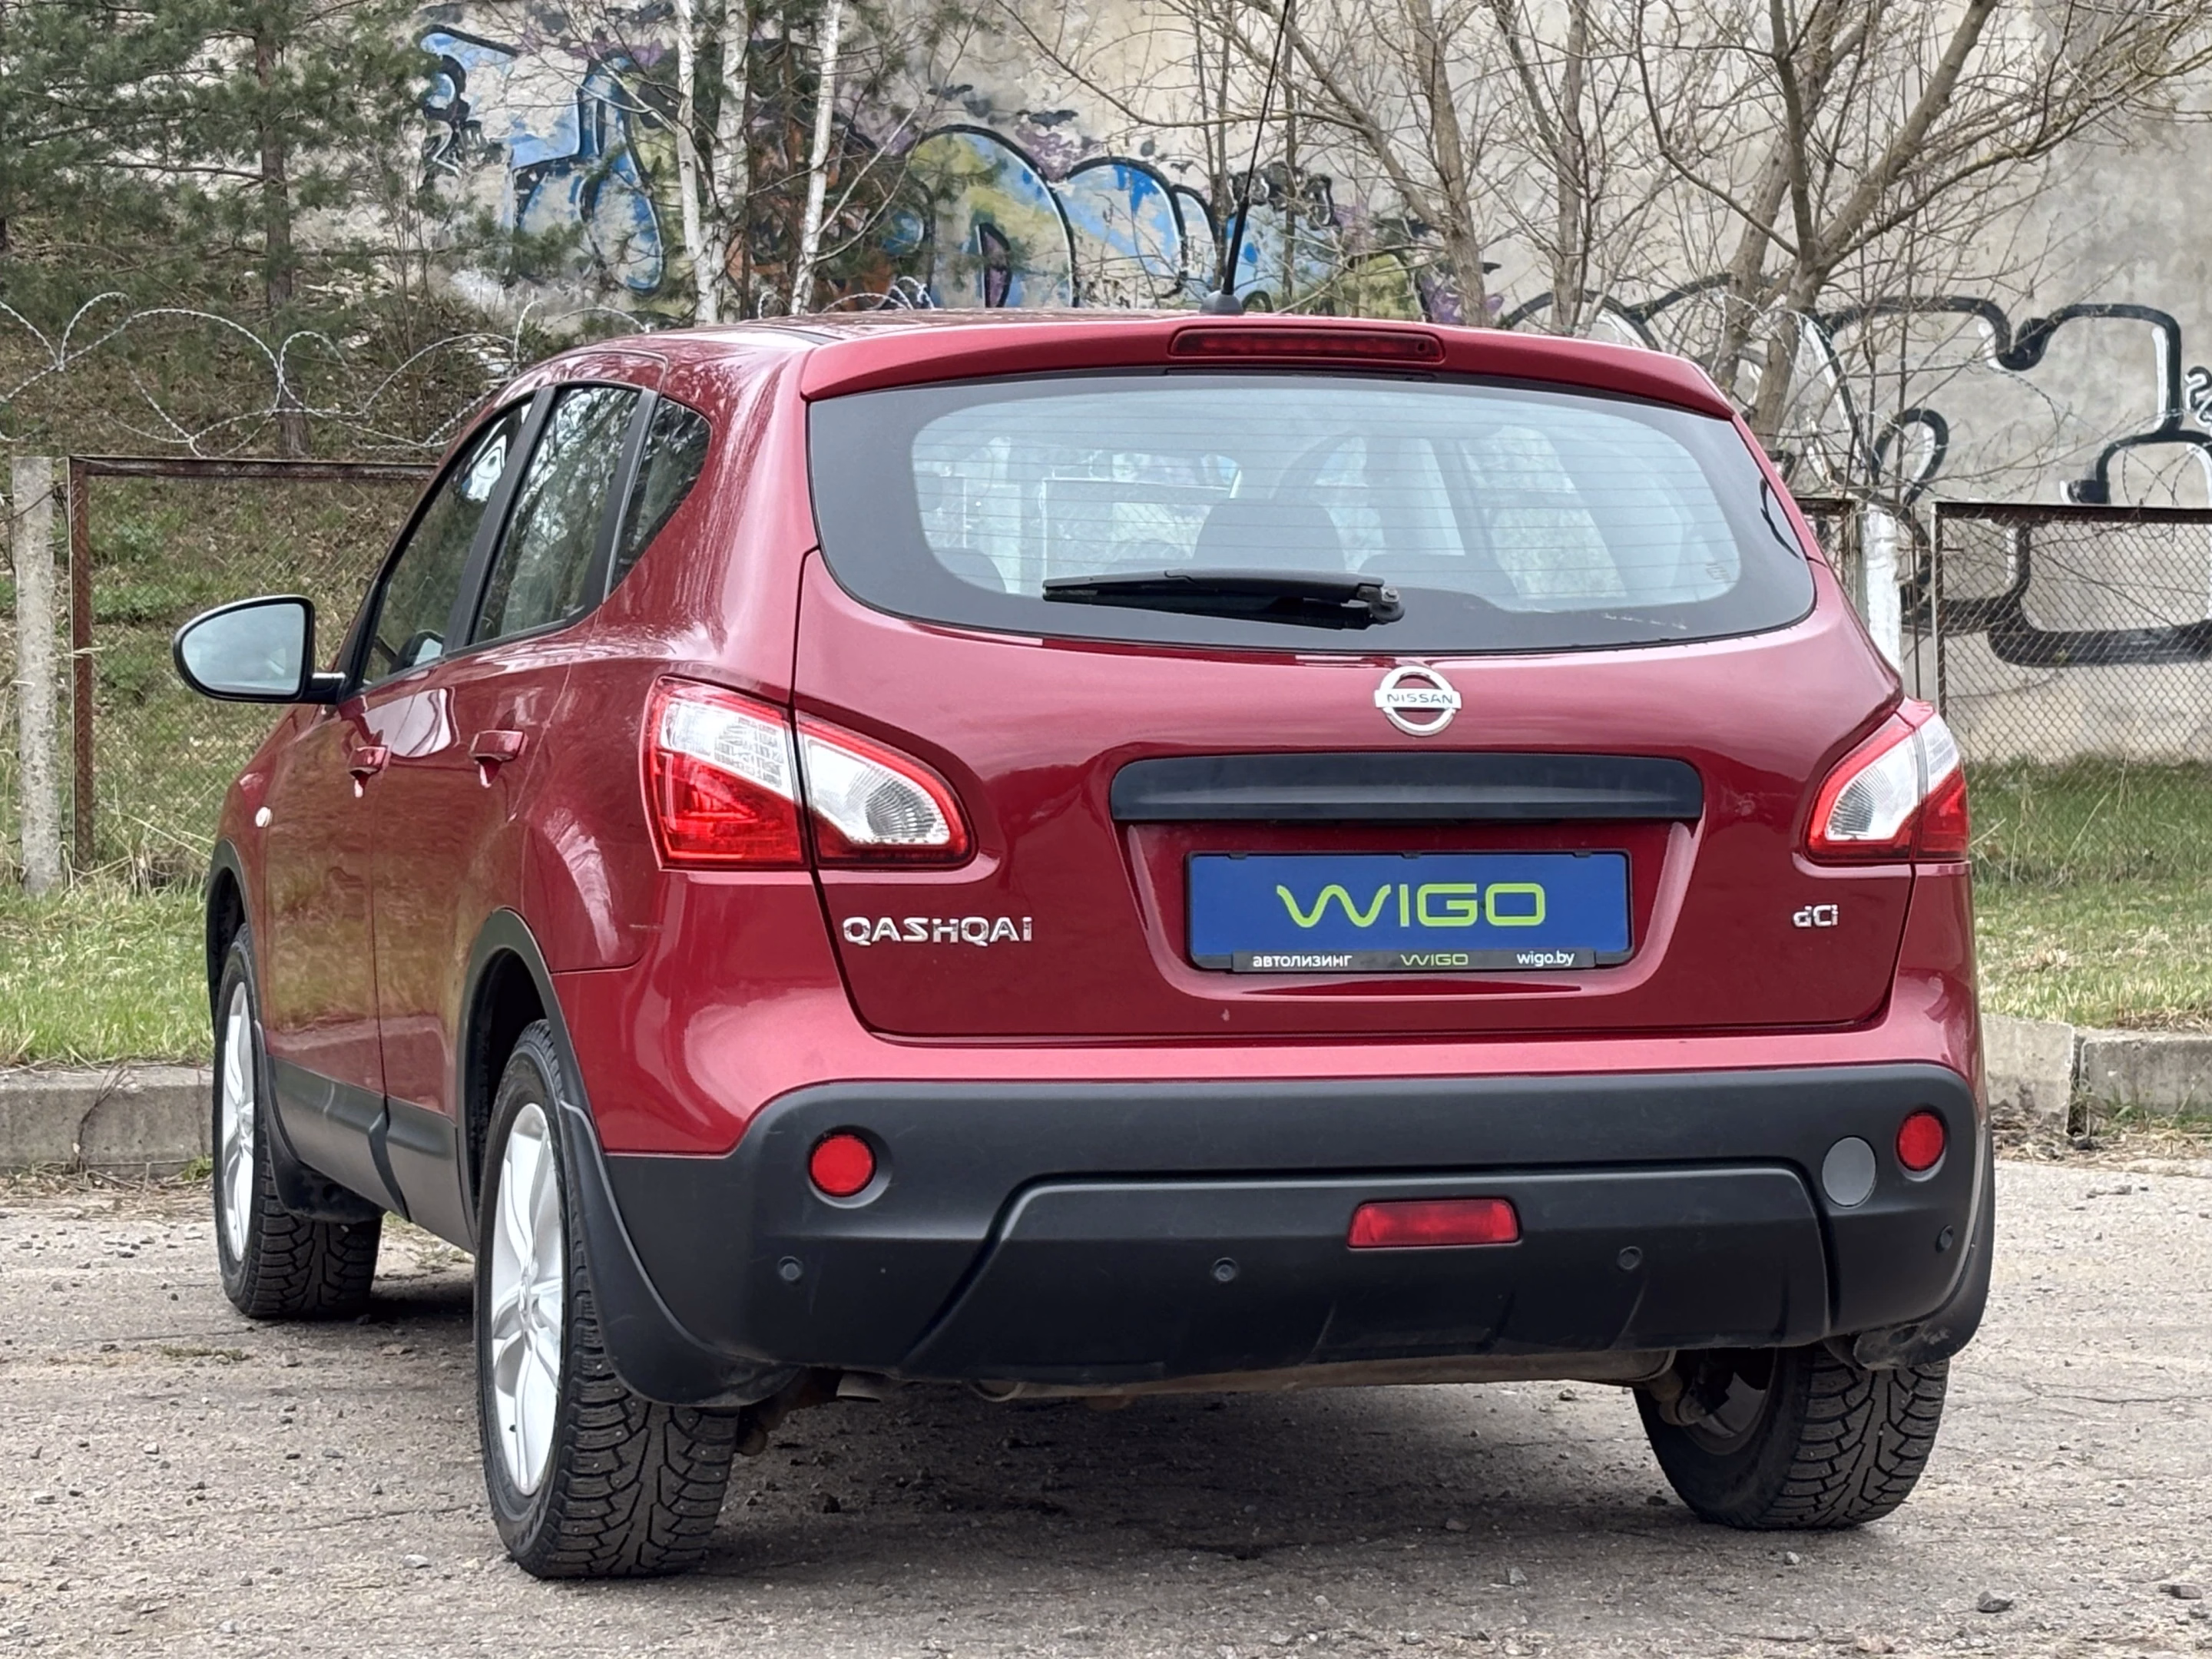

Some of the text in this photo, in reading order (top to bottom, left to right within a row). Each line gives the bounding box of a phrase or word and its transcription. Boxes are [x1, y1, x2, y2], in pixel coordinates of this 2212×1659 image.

[1386, 693, 1453, 704] NISSAN
[1277, 882, 1545, 928] WIGO
[1793, 904, 1839, 928] dCi
[1252, 954, 1353, 968] автолизинг
[1400, 953, 1469, 966] WIGO
[1516, 949, 1575, 967] wigo.by
